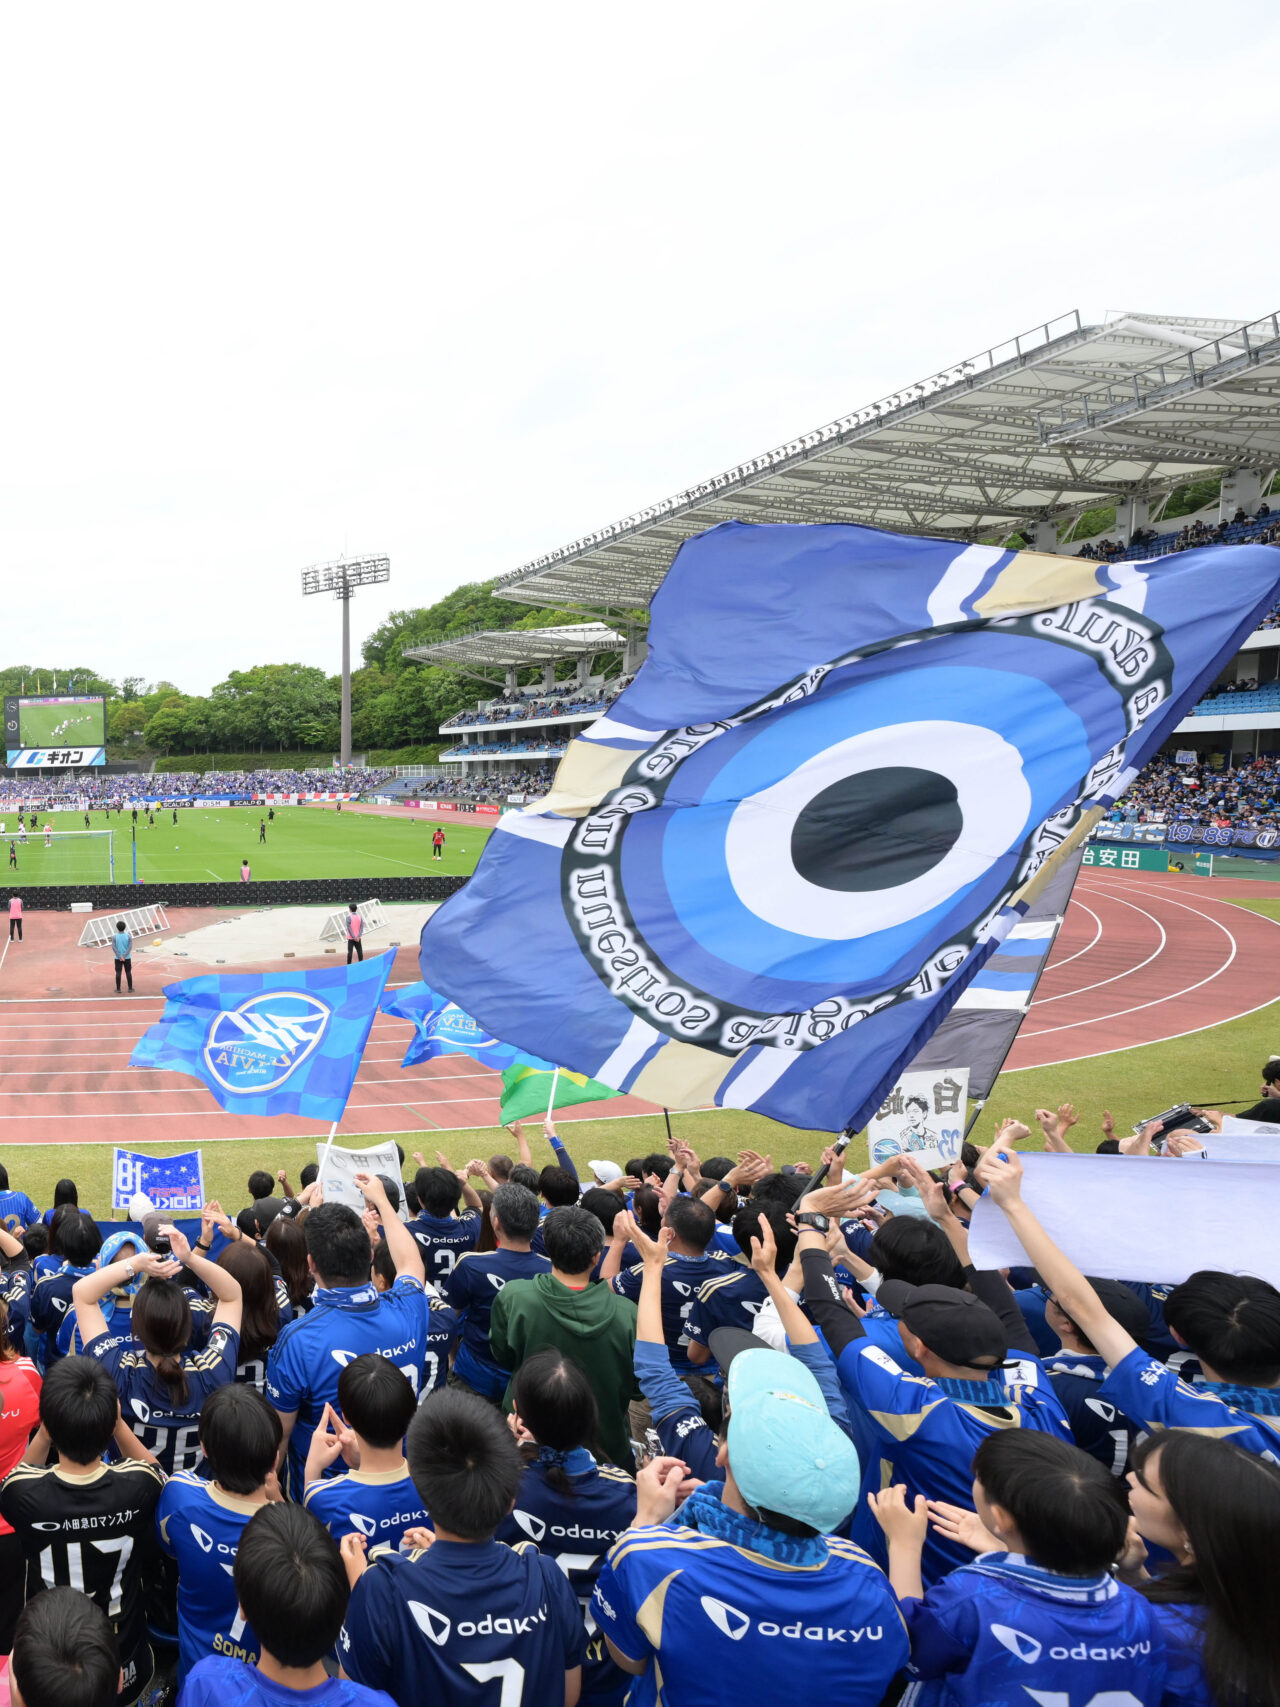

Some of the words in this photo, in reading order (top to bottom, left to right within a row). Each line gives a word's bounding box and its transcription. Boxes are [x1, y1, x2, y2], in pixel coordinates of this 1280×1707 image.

[47, 750, 83, 765] ギオン
[432, 1234, 470, 1245] odakyu
[62, 1509, 141, 1532] 小田急ロマンスカー
[757, 1620, 884, 1643] odakyu
[1048, 1640, 1152, 1662] odakyu
[459, 1656, 526, 1707] 7
